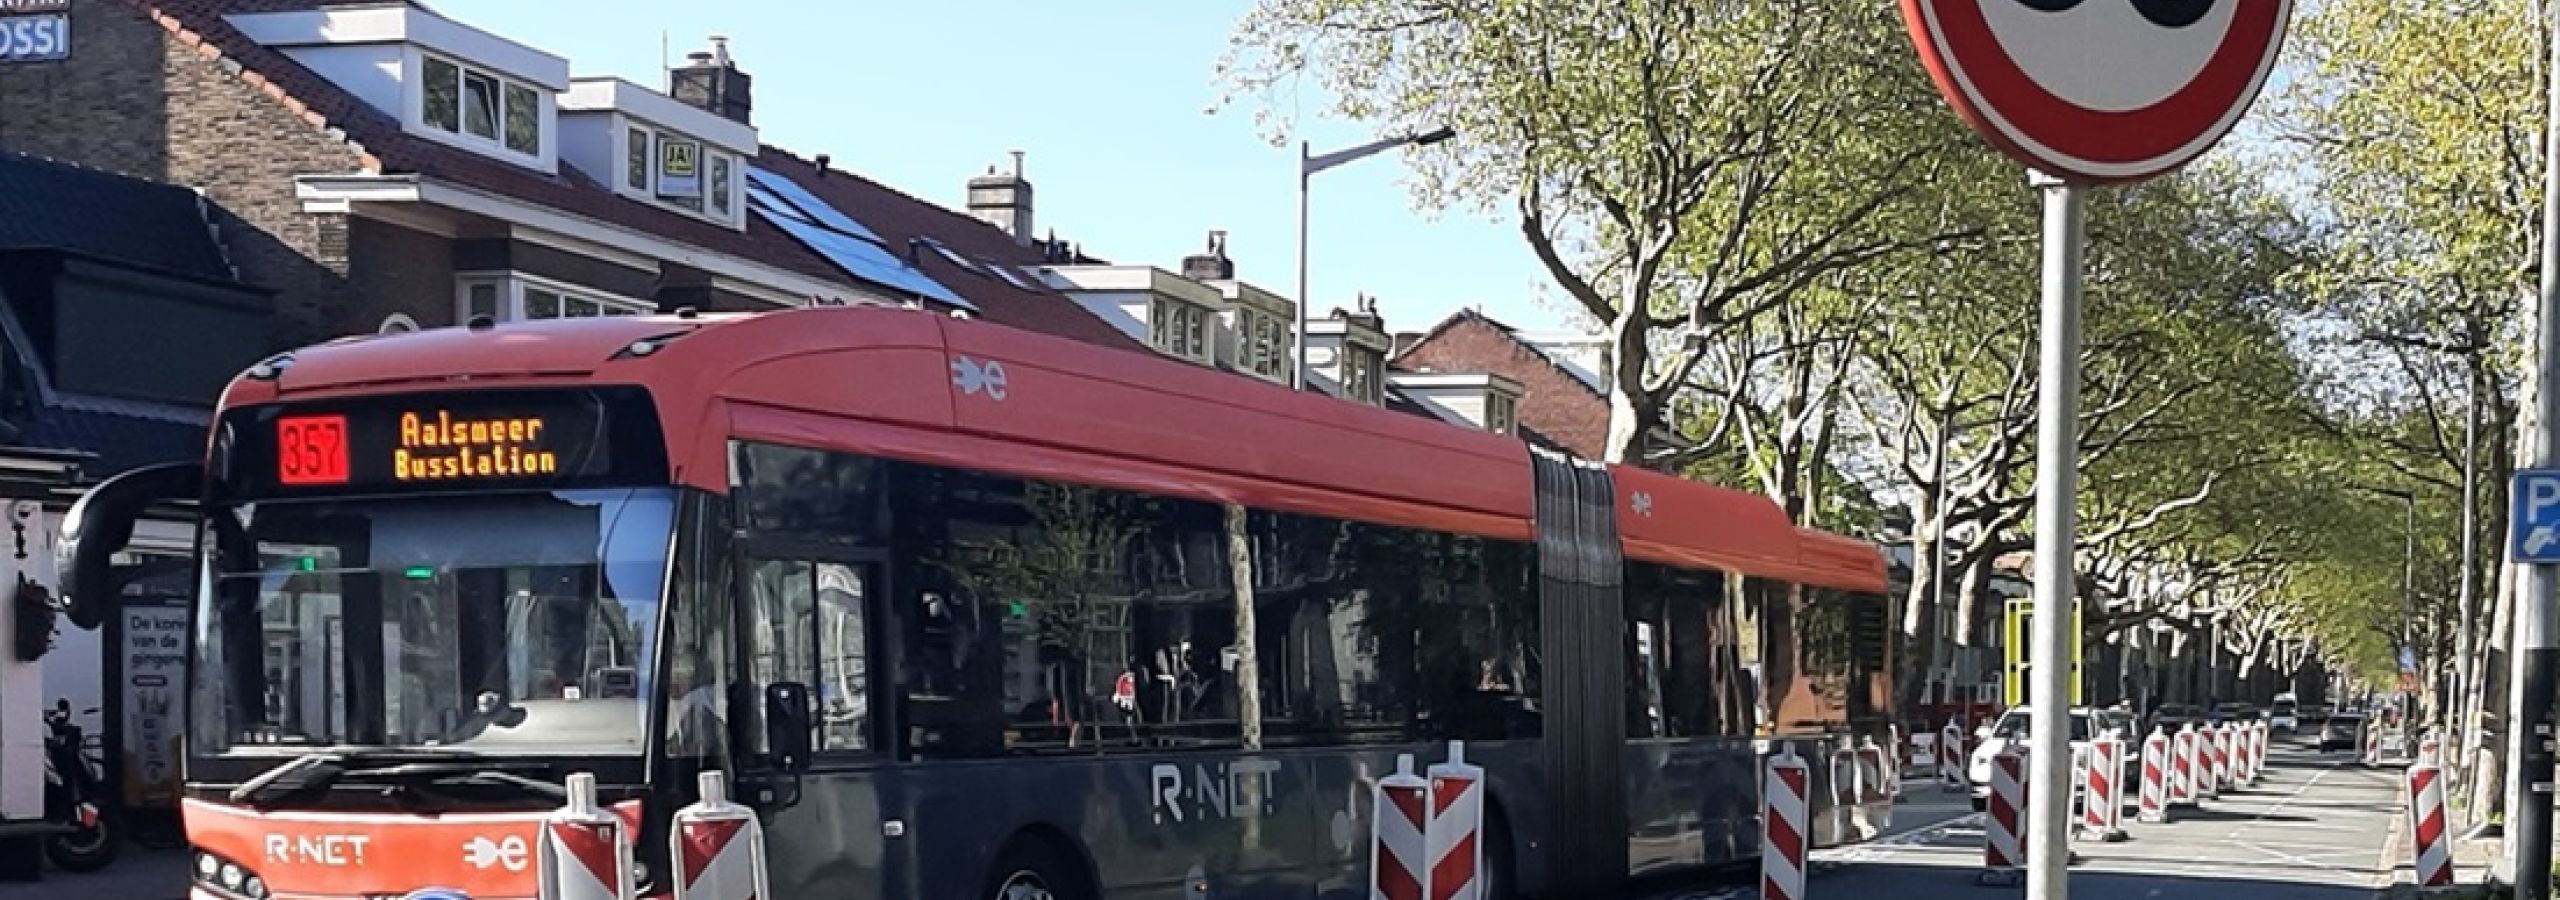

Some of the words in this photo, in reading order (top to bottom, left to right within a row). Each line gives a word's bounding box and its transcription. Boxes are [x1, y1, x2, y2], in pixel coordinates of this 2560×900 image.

[401, 410, 543, 446] Aalsmeer
[284, 424, 341, 476] 357
[394, 445, 556, 479] Busstation
[2527, 478, 2560, 523] P
[131, 616, 151, 630] De
[160, 633, 178, 648] de
